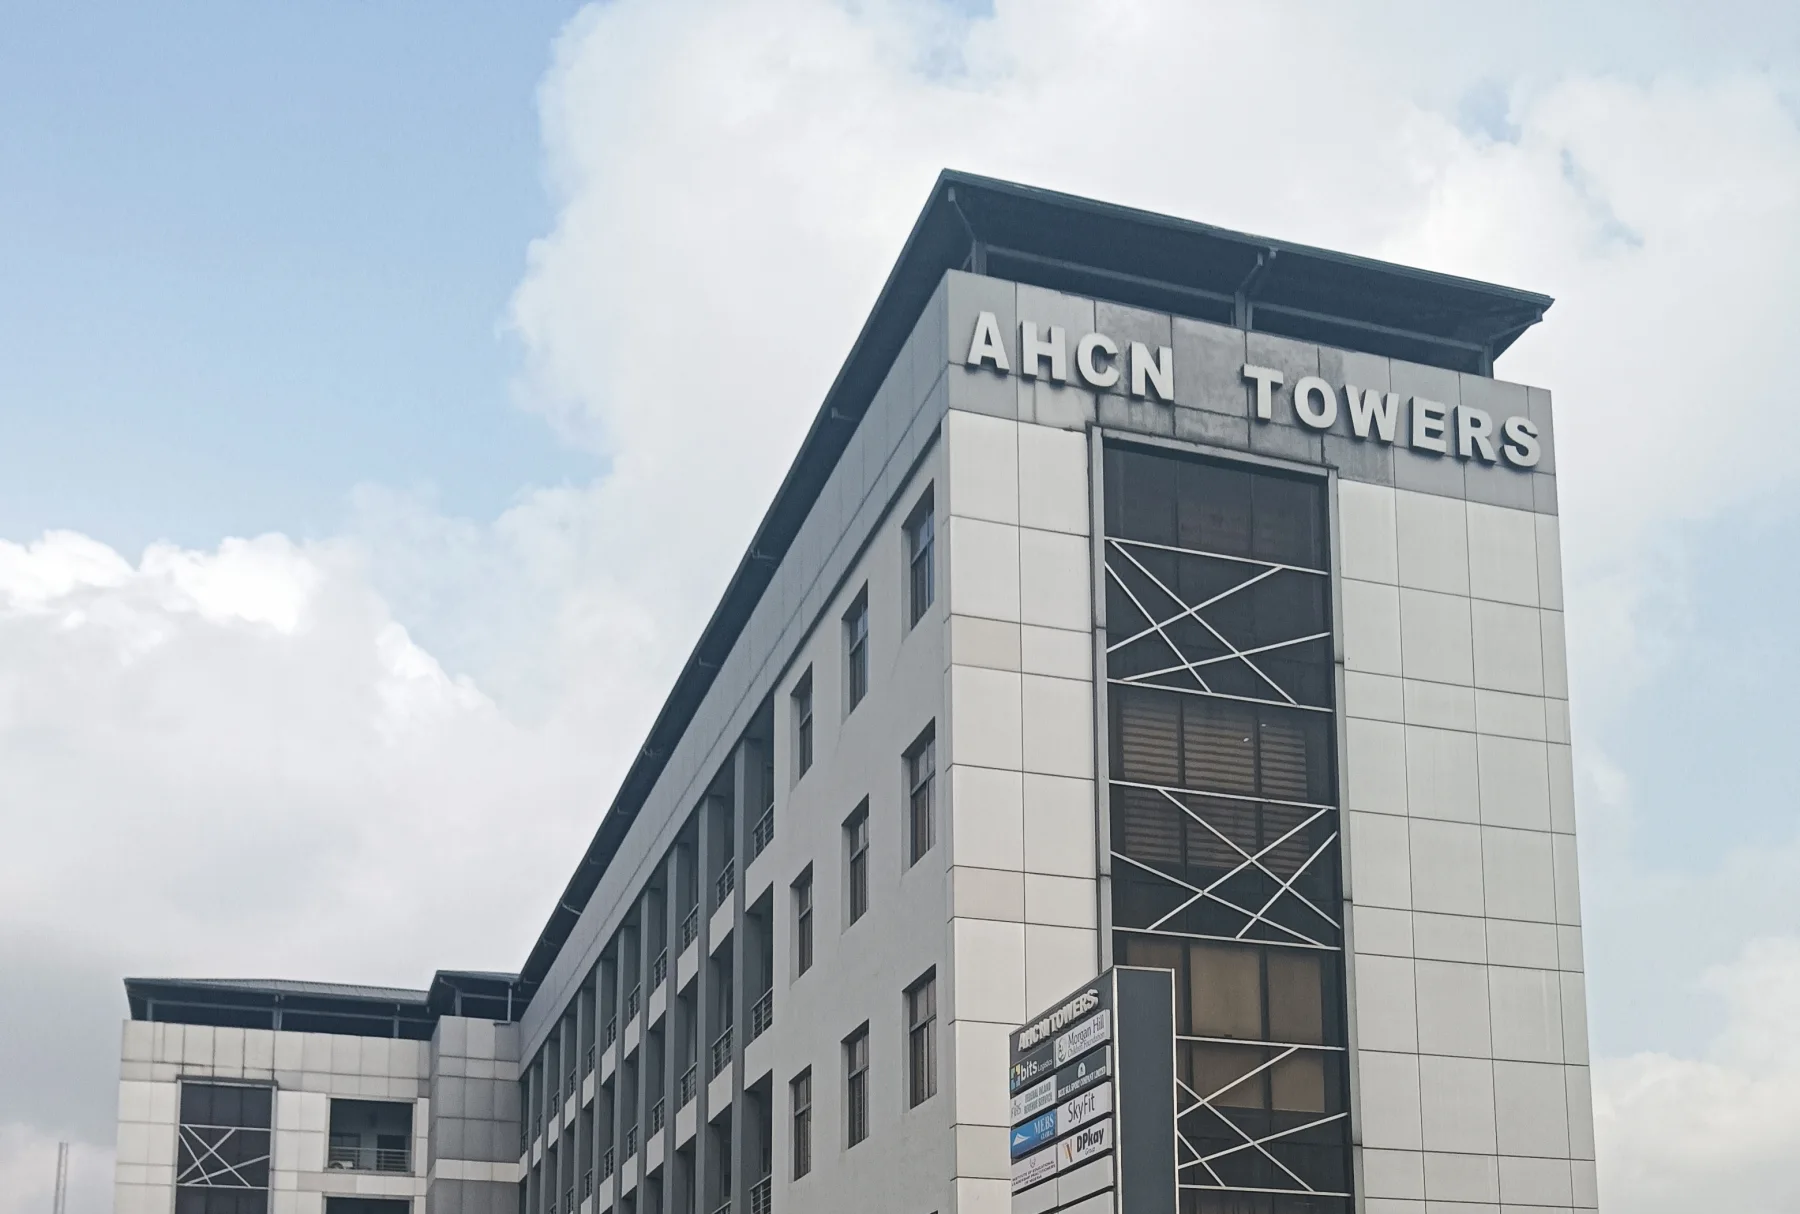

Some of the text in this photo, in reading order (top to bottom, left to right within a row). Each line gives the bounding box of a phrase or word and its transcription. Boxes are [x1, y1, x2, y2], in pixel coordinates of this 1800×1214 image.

[966, 311, 1541, 469] AHCN TOWERS
[1018, 989, 1098, 1051] AHCN TOWERS
[1068, 1014, 1104, 1046] Morgan Hill
[1021, 1059, 1052, 1081] bits Logistics
[1068, 1092, 1095, 1123] SkyFit
[1034, 1114, 1053, 1134] MEBS
[1077, 1128, 1104, 1152] DPkay
